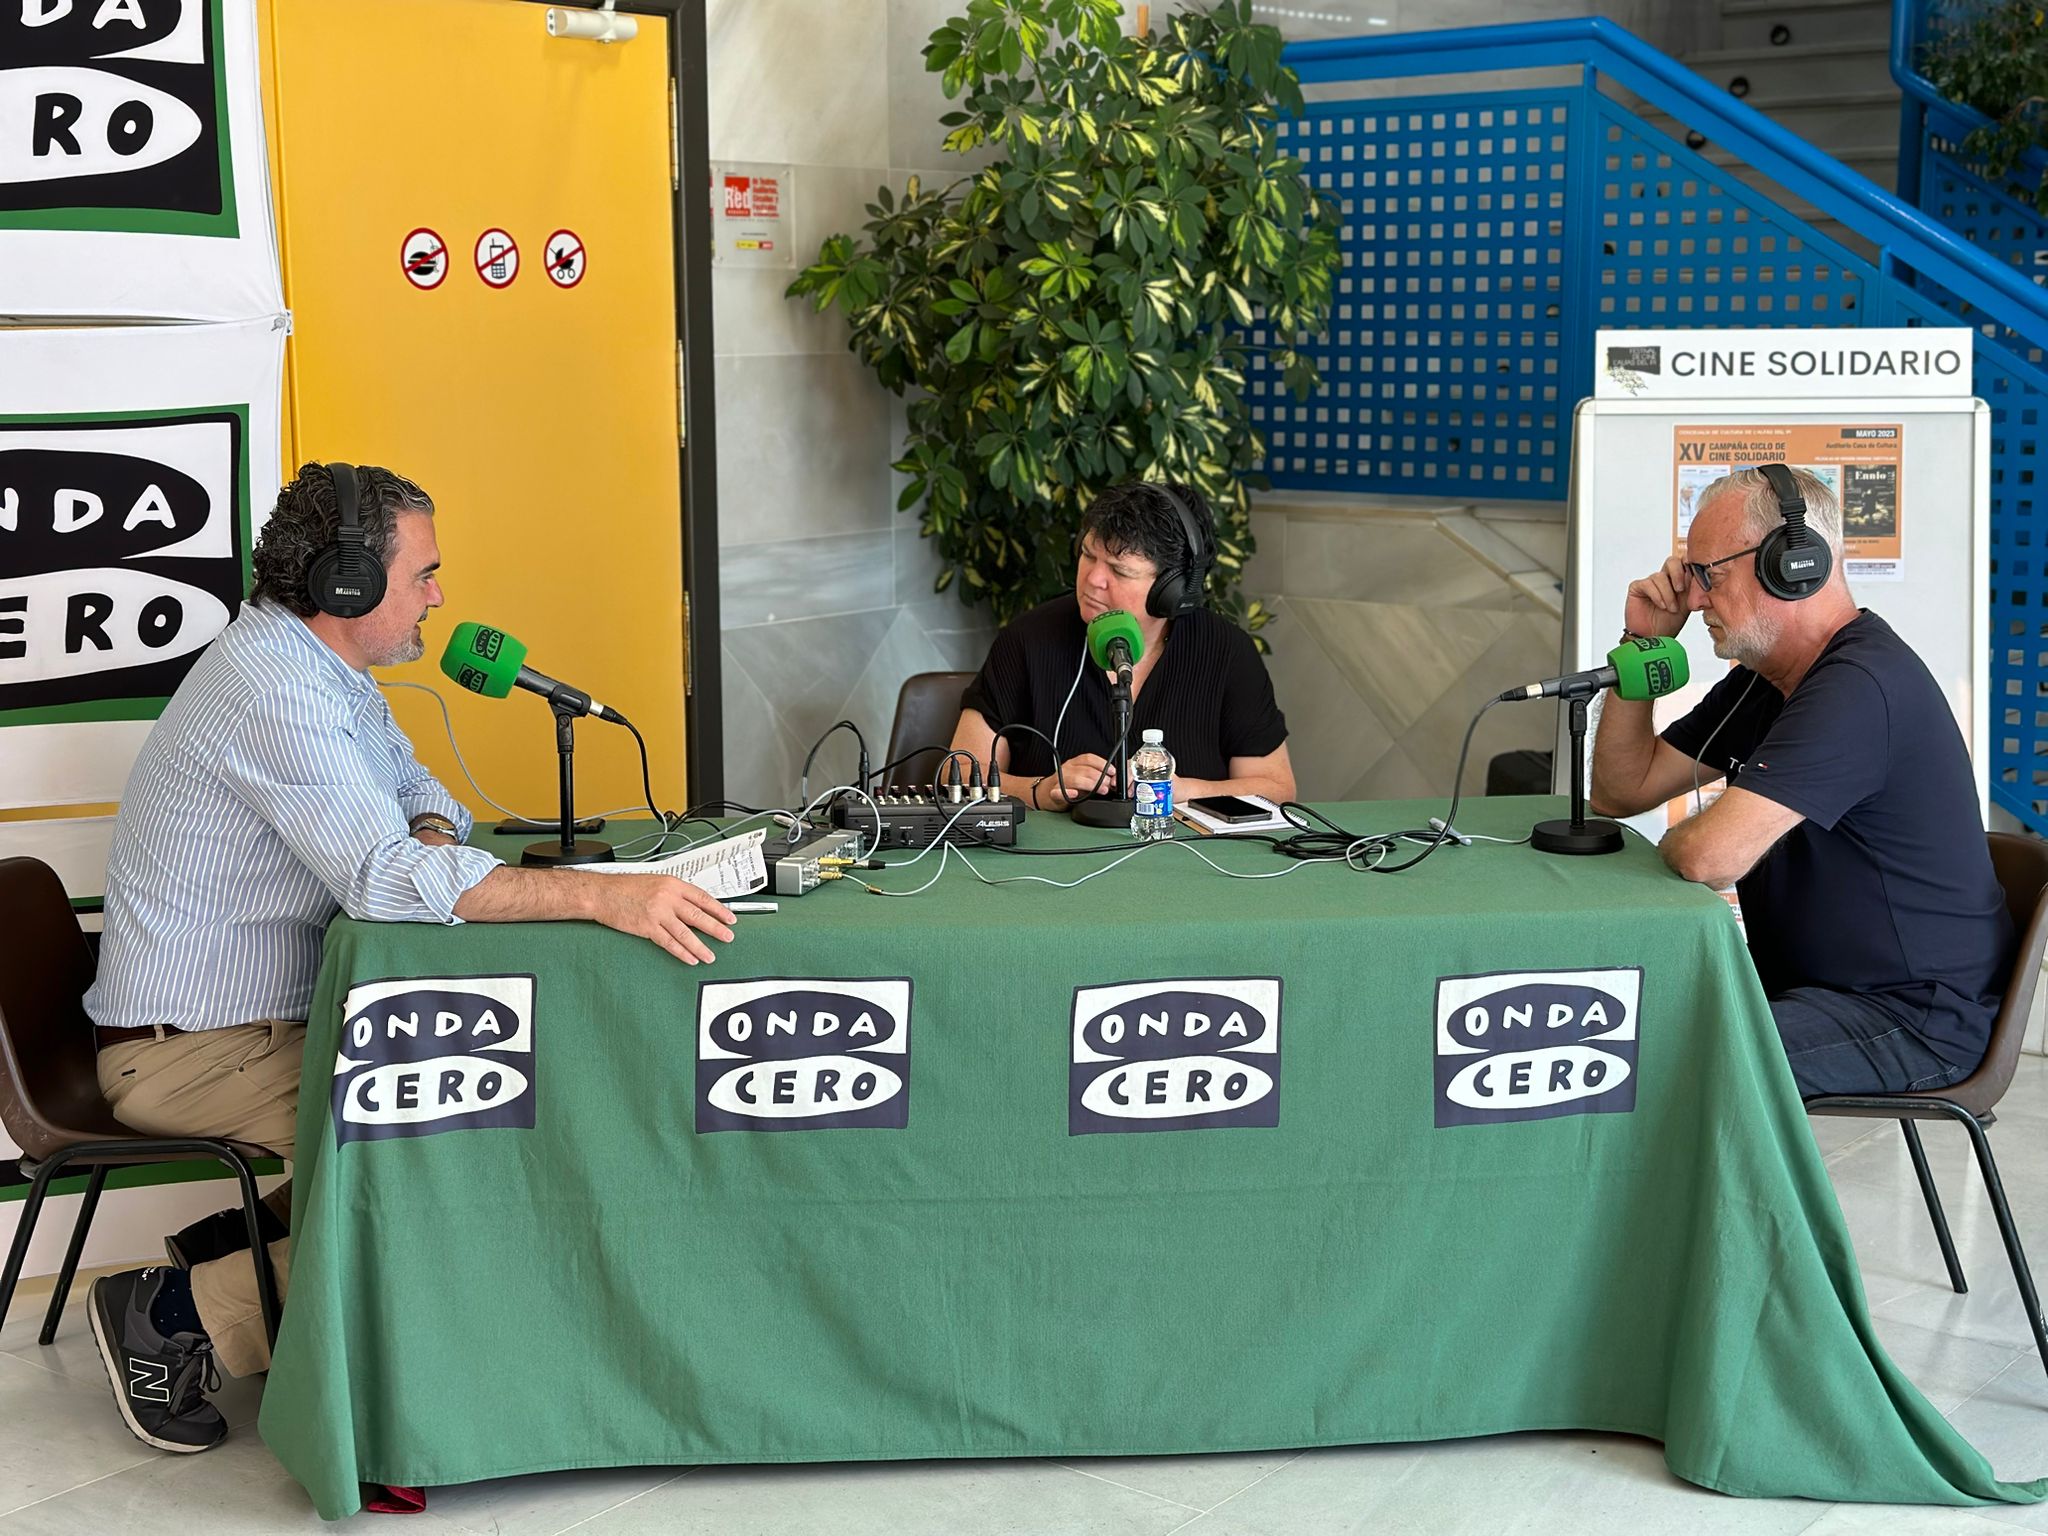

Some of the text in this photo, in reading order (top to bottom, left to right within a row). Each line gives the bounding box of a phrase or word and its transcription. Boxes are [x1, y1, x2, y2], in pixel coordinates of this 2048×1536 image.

[725, 186, 750, 208] Red
[1671, 350, 1961, 376] CINE SOLIDARIO
[1680, 443, 1705, 461] XV
[1709, 441, 1748, 450] CAMPAÑA
[1709, 452, 1785, 461] CINE SOLIDARIO
[1855, 471, 1886, 480] Ennio
[975, 820, 1010, 828] ALESIS
[352, 1010, 501, 1048] ONDA
[727, 1010, 877, 1042] ONDA
[1100, 1011, 1248, 1044] ONDA
[1464, 1001, 1608, 1037] ONDA
[356, 1071, 502, 1111] CERO
[735, 1070, 878, 1104] CERO
[1108, 1068, 1248, 1105] CERO
[1473, 1060, 1608, 1097] CERO
